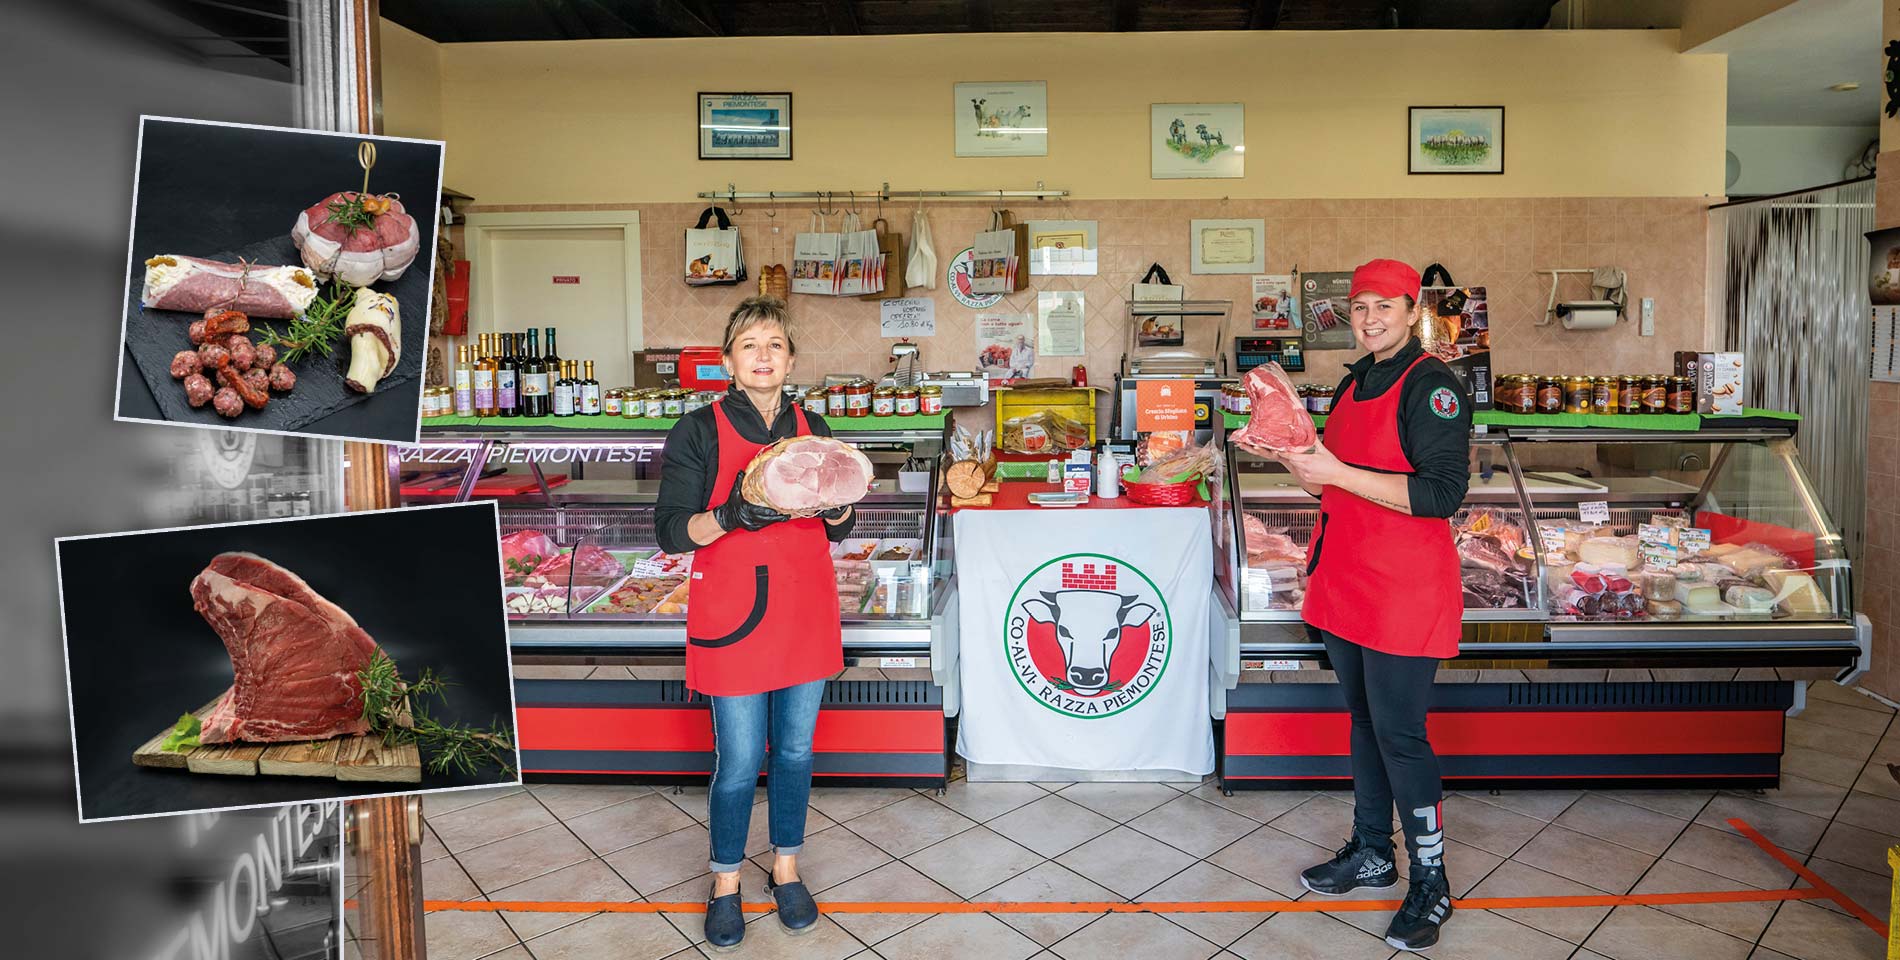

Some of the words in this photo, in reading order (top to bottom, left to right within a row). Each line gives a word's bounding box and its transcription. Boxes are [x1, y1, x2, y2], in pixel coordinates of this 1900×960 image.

[487, 446, 652, 464] PIEMONTESE
[1039, 686, 1099, 715] RAZZA
[1103, 621, 1166, 712] PIEMONTESE
[1356, 861, 1393, 880] adidas
